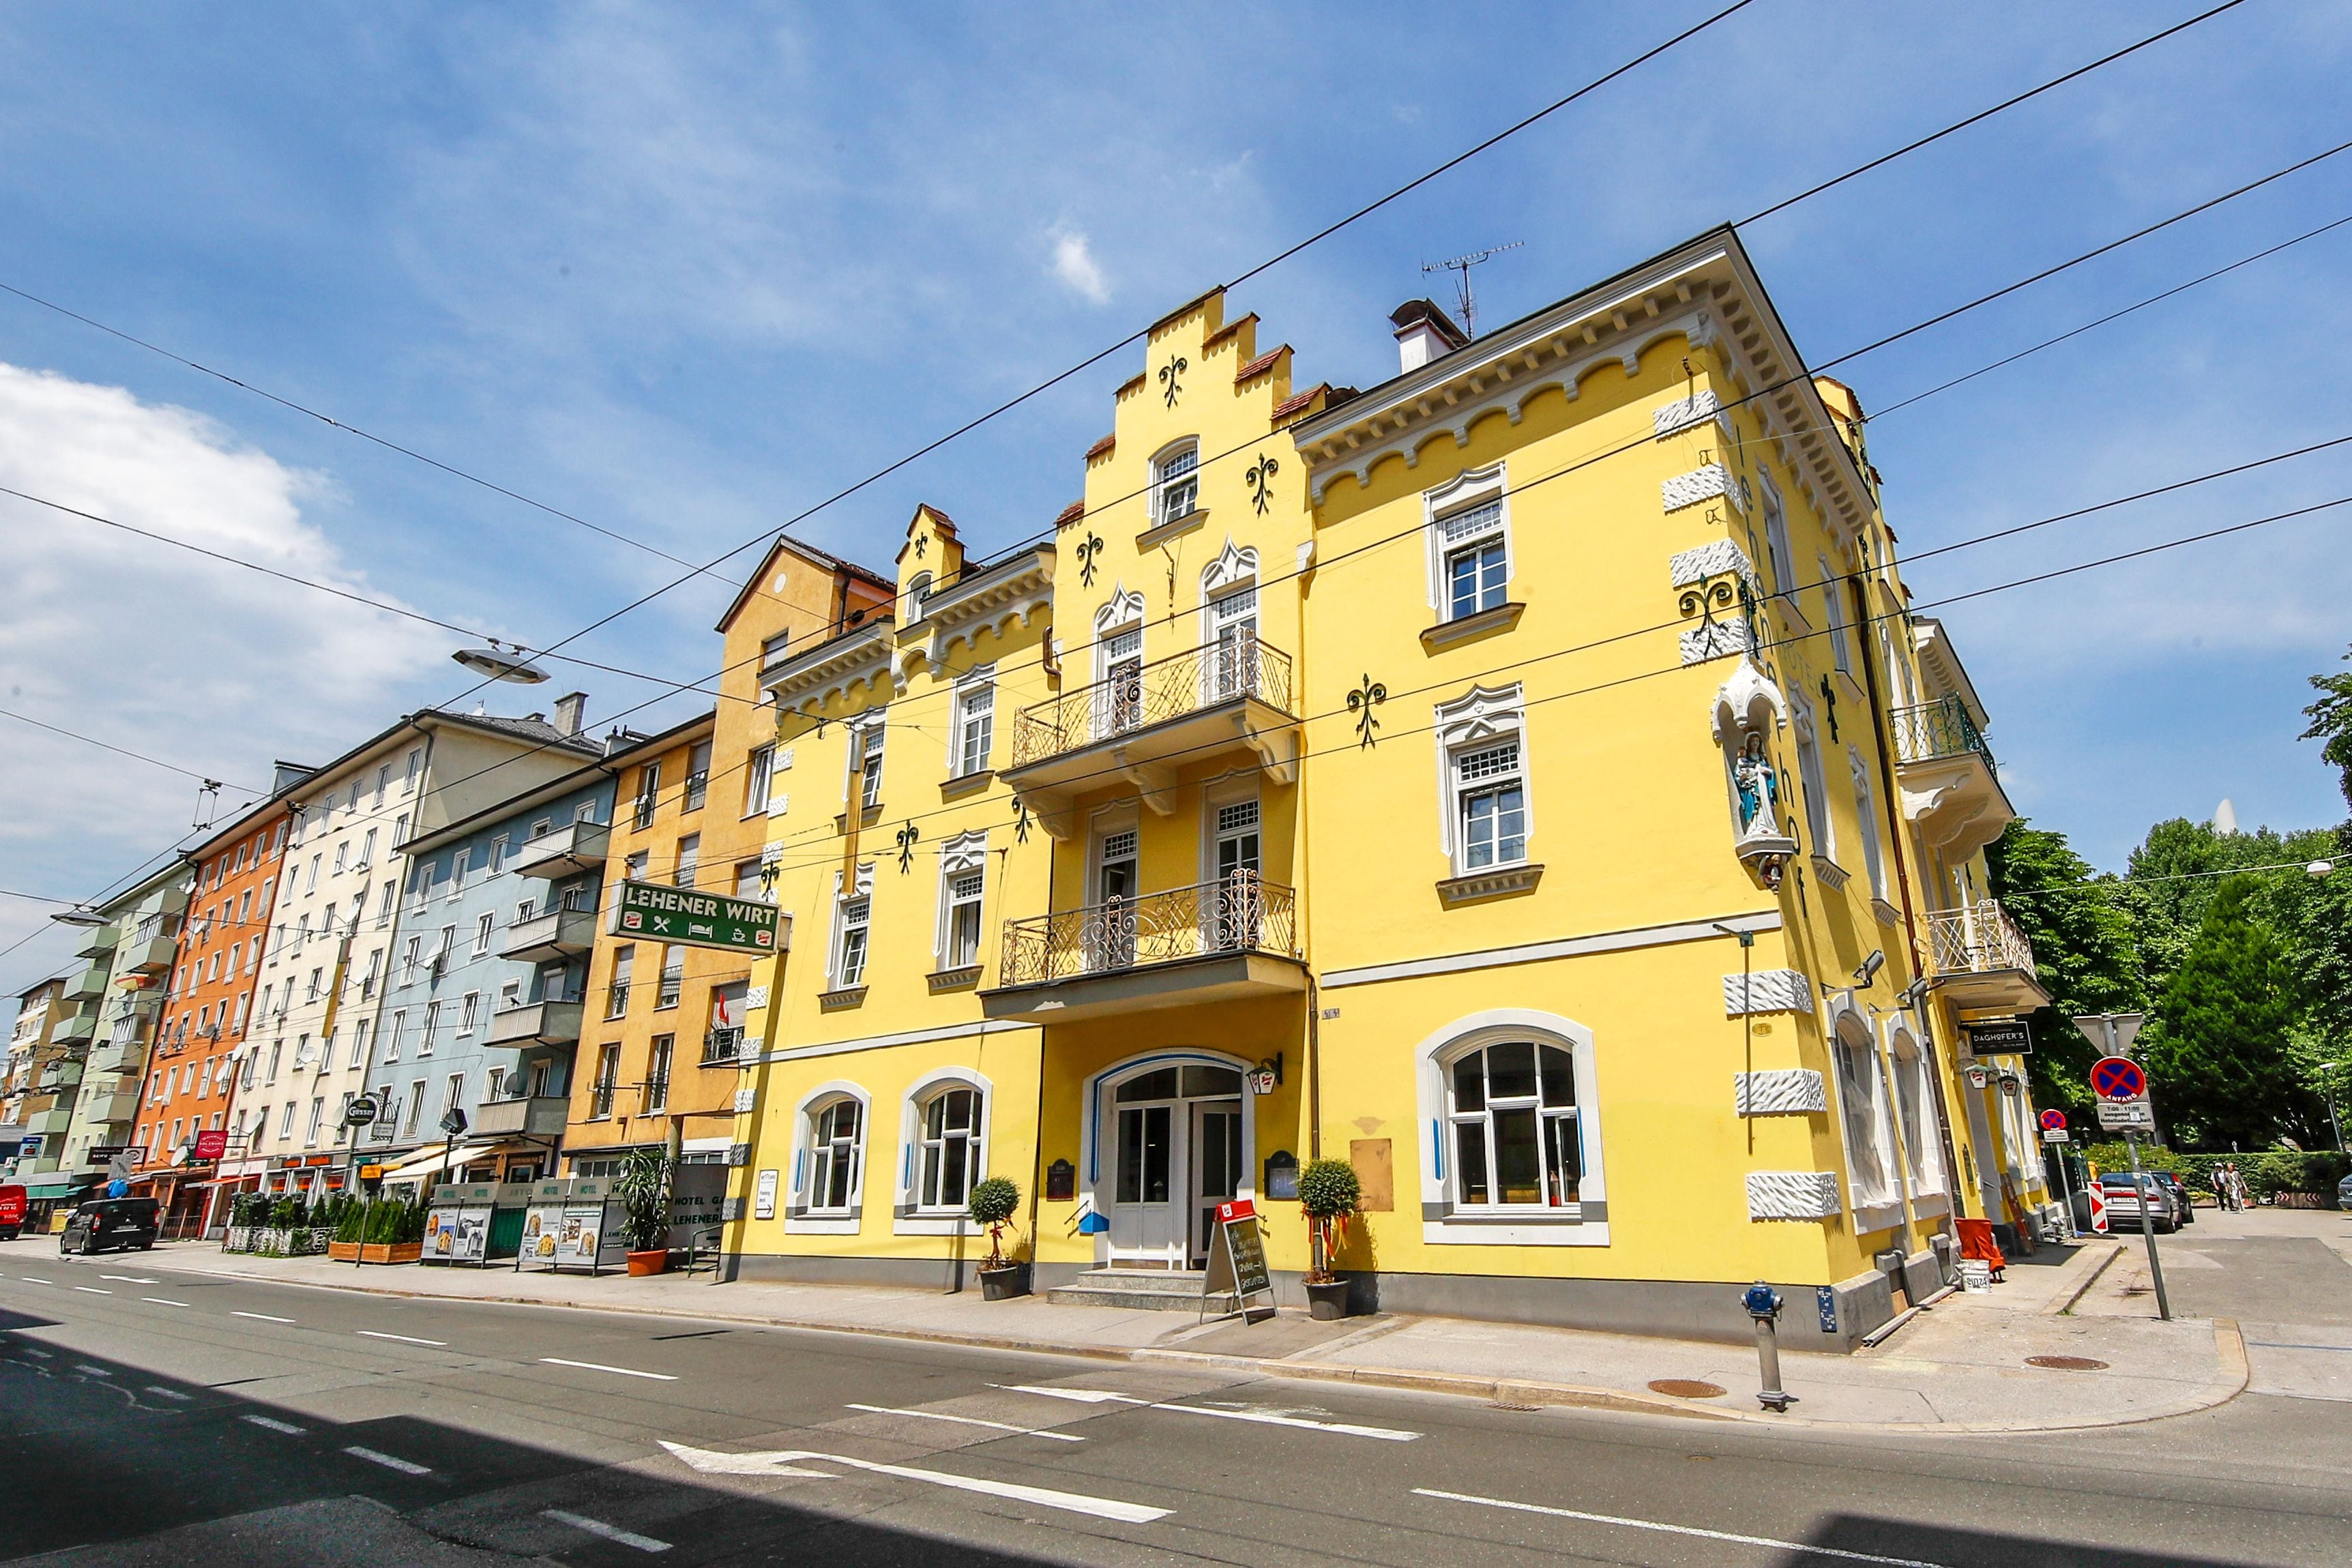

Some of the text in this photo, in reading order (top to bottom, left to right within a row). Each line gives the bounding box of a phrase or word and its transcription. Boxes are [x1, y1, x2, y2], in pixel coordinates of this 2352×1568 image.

[626, 887, 775, 925] LEHENER WIRT
[1973, 1033, 2025, 1041] DAGHOFER'S
[2106, 1093, 2138, 1102] ANFANG
[674, 1196, 724, 1207] HOTEL GA
